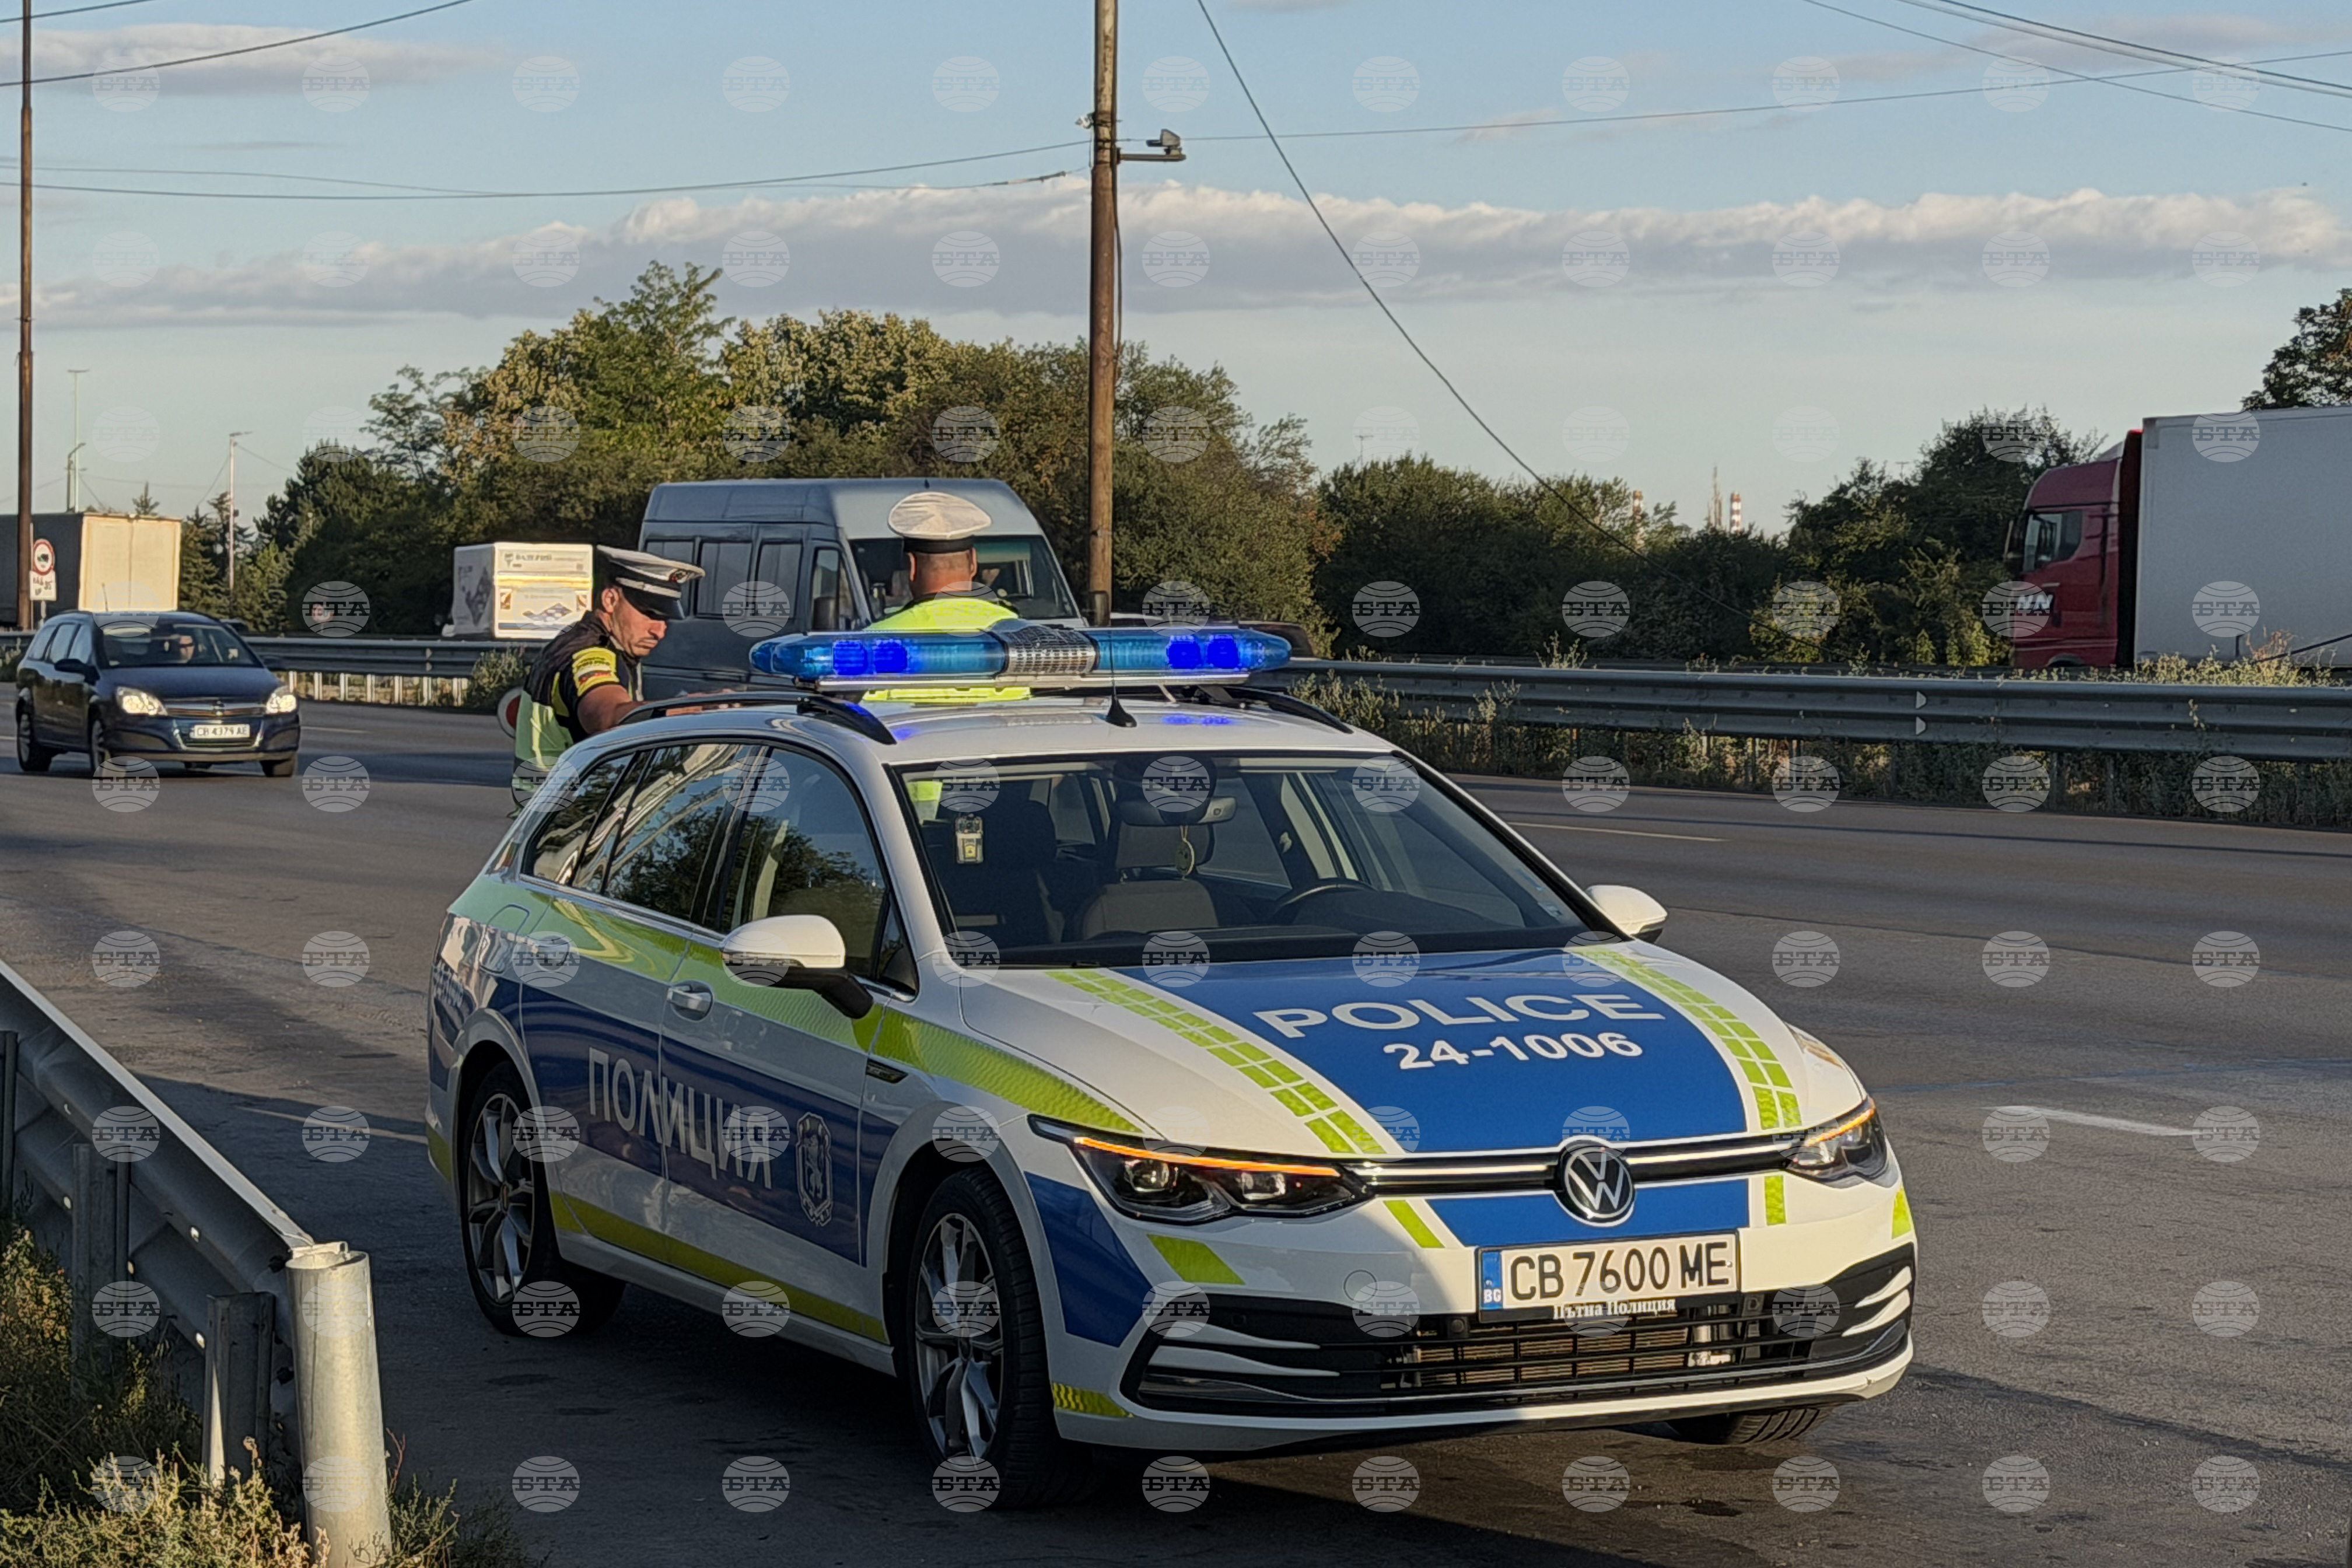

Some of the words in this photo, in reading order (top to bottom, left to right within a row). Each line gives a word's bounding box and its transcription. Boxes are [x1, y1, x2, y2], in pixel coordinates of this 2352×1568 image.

[1252, 994, 1665, 1038] POLICE
[1383, 1032, 1643, 1069] 24-1006
[589, 1046, 771, 1189] ПОЛИЦИЯ
[1510, 1254, 1564, 1300] CB
[1573, 1247, 1670, 1296] 7600
[1679, 1241, 1729, 1289] ME
[1483, 1288, 1502, 1303] BG
[1606, 1298, 1676, 1316] Полиция
